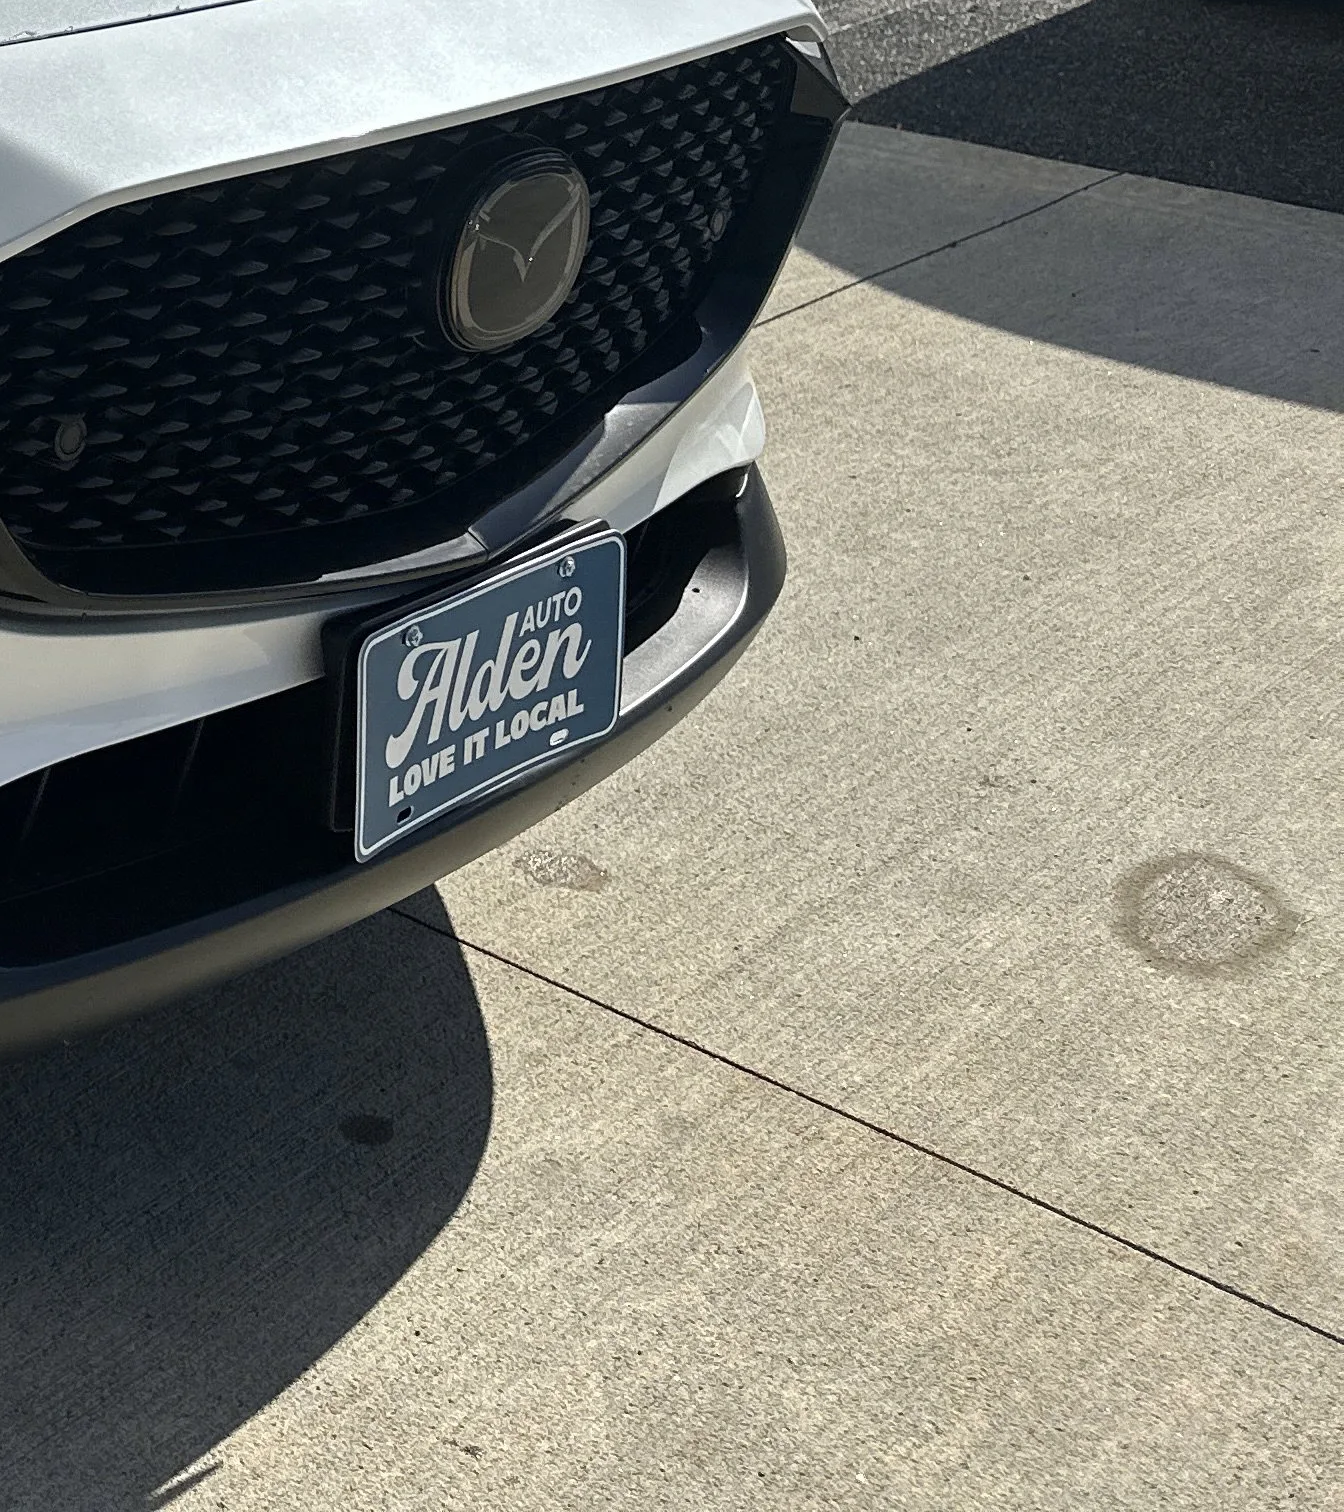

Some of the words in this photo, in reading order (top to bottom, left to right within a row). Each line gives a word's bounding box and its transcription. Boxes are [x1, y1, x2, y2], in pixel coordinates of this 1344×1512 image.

[519, 586, 583, 637] AUTO
[385, 611, 592, 769] Alden
[389, 744, 456, 808] LOVE
[463, 727, 490, 766] IT
[495, 688, 585, 750] LOCAL
